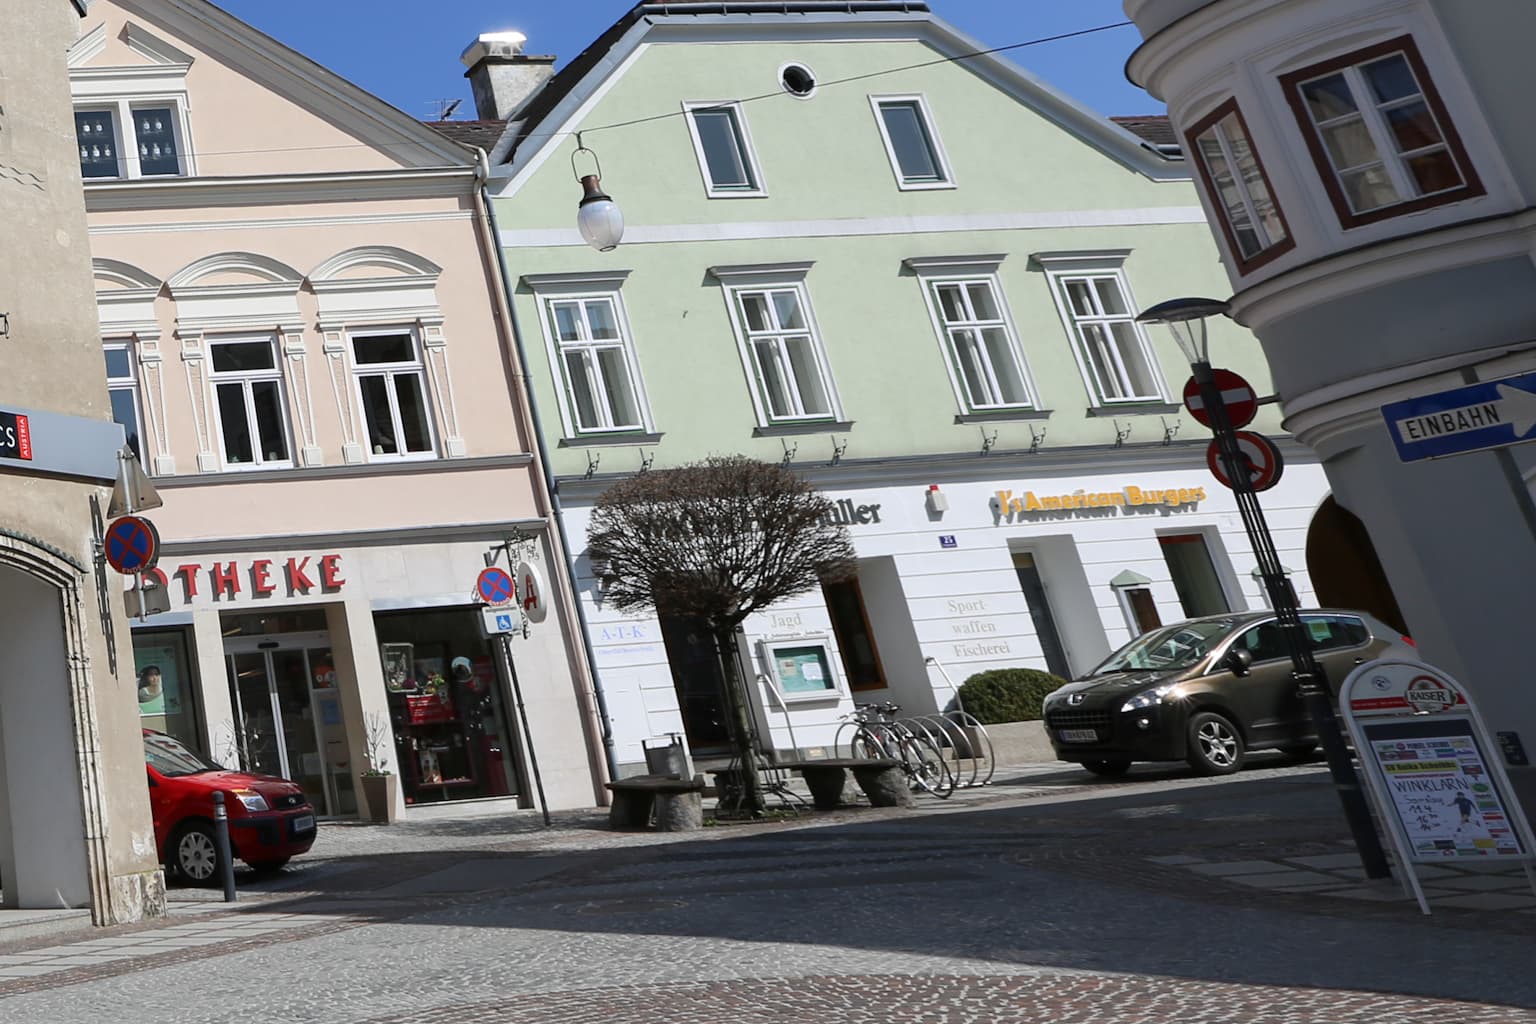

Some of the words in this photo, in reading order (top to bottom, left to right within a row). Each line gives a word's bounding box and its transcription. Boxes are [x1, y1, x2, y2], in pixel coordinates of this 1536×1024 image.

[1405, 404, 1501, 439] EINBAHN
[20, 418, 29, 457] AUSTRIA
[1024, 491, 1126, 512] American
[1127, 485, 1206, 507] Burgers
[770, 613, 802, 629] Jagd
[952, 619, 996, 634] waffen
[953, 640, 1011, 657] Fischerei
[1409, 690, 1447, 702] KAISER
[1393, 778, 1470, 792] WINKLARN
